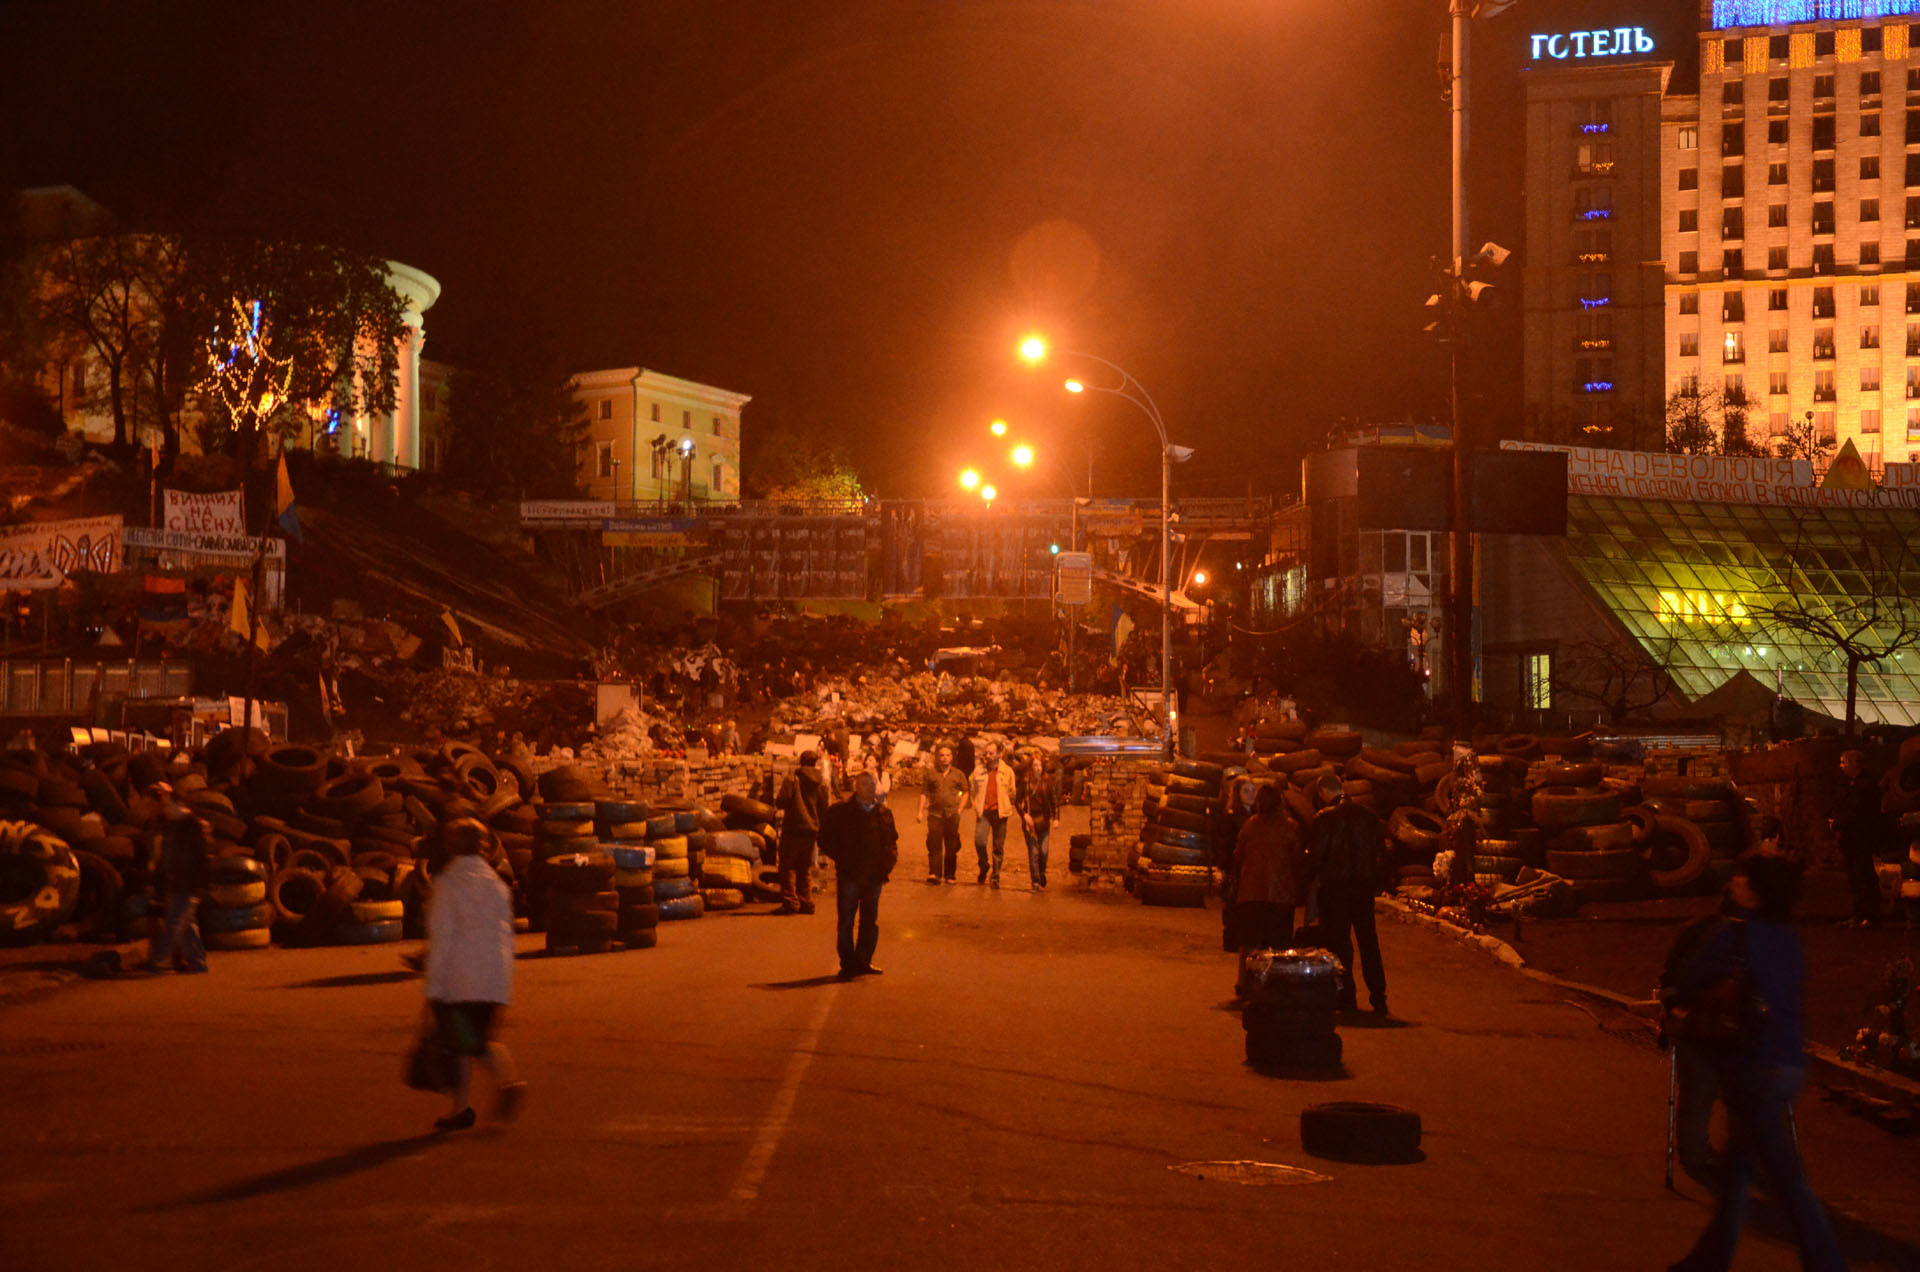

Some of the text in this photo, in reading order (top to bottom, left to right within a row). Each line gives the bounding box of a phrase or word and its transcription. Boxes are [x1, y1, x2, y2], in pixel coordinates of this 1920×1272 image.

[1633, 453, 1794, 485] РЕВОЛЮЦІЯ
[169, 492, 237, 506] ВИННИХ
[190, 506, 213, 518] НА
